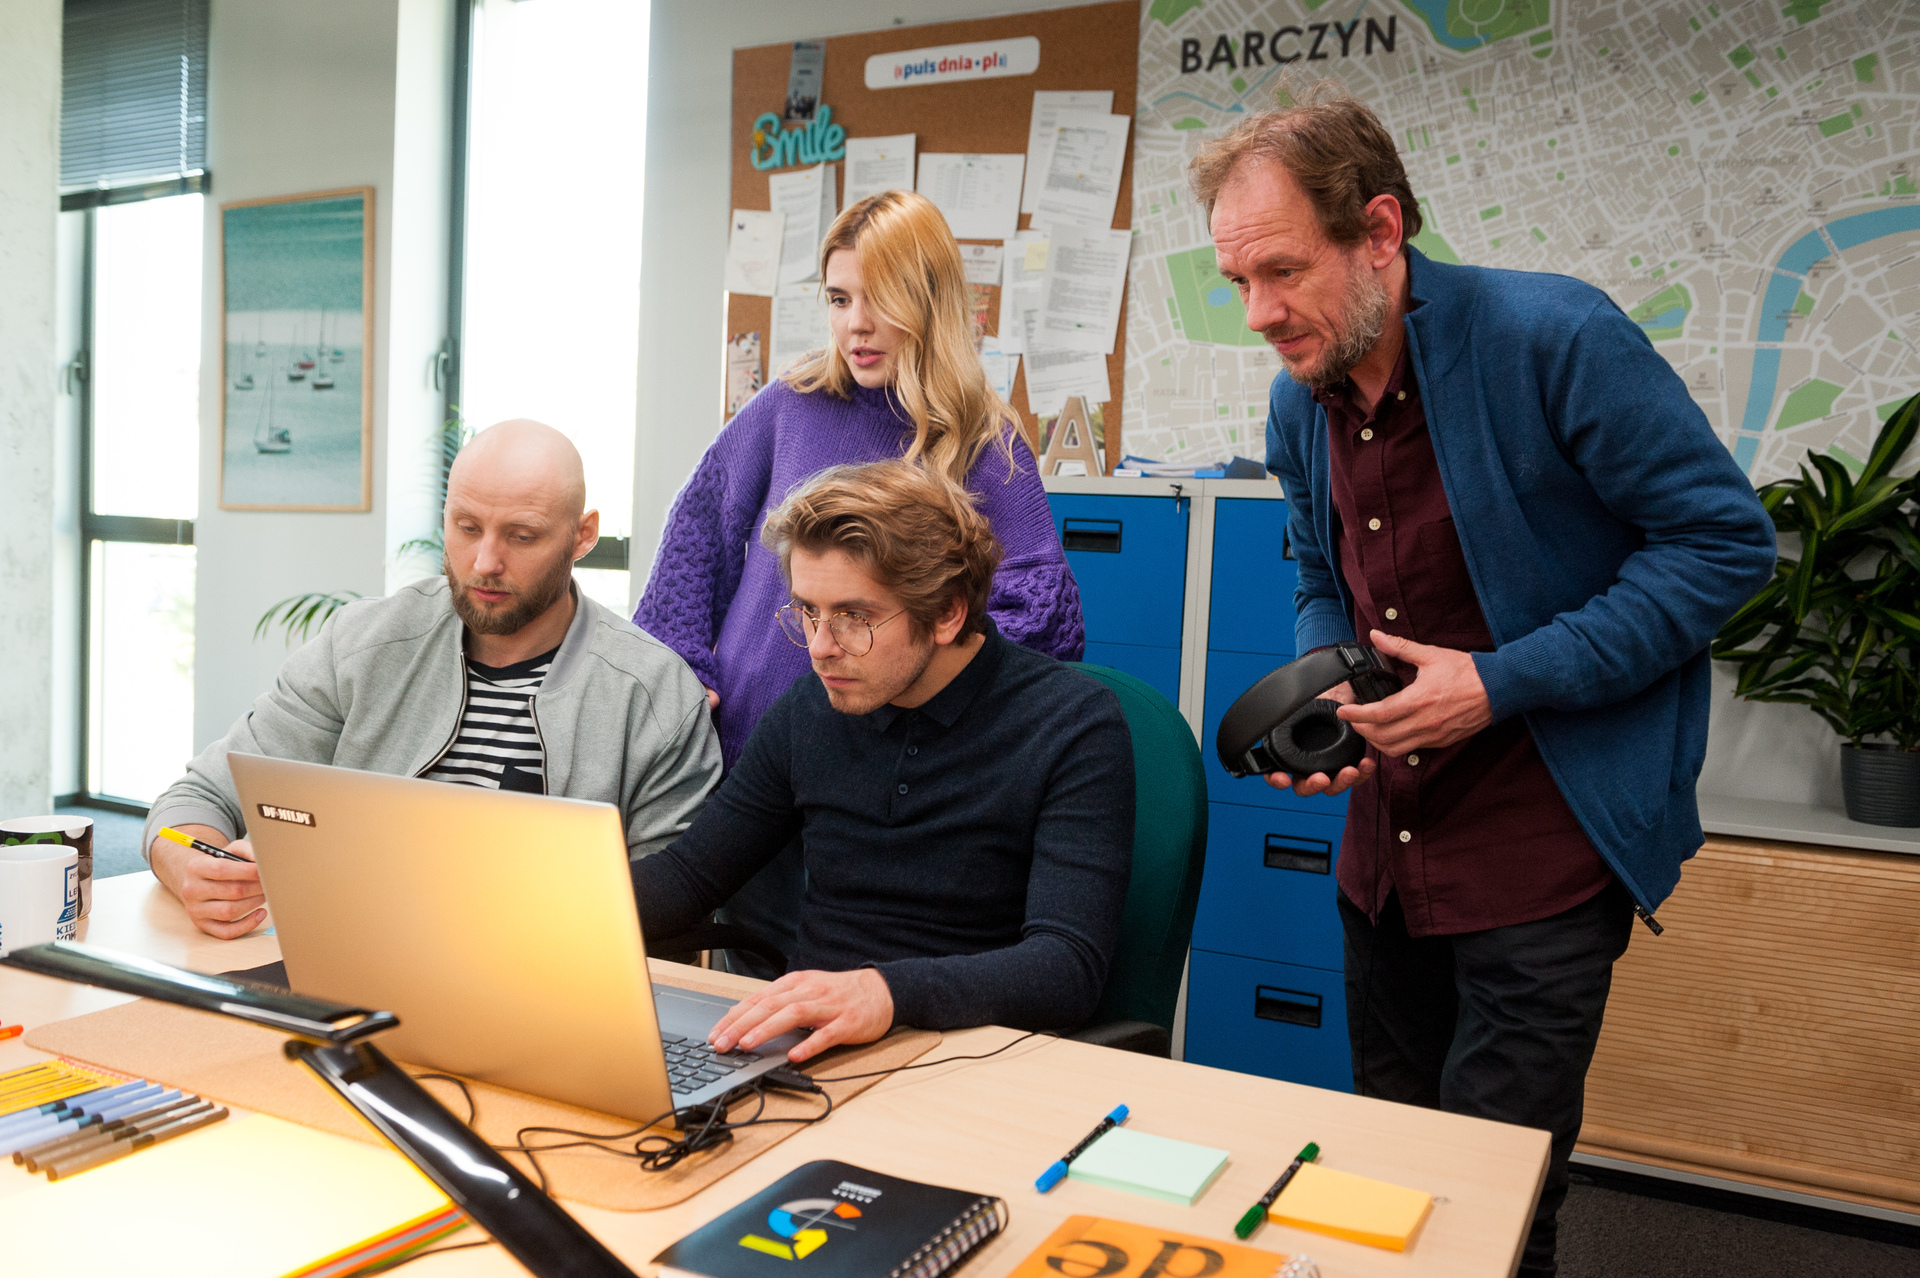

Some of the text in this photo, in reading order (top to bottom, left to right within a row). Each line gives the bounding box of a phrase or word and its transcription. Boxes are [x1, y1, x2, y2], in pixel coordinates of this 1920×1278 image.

[1181, 14, 1397, 74] BARCZYN
[750, 104, 846, 171] Smile
[1041, 395, 1104, 477] A
